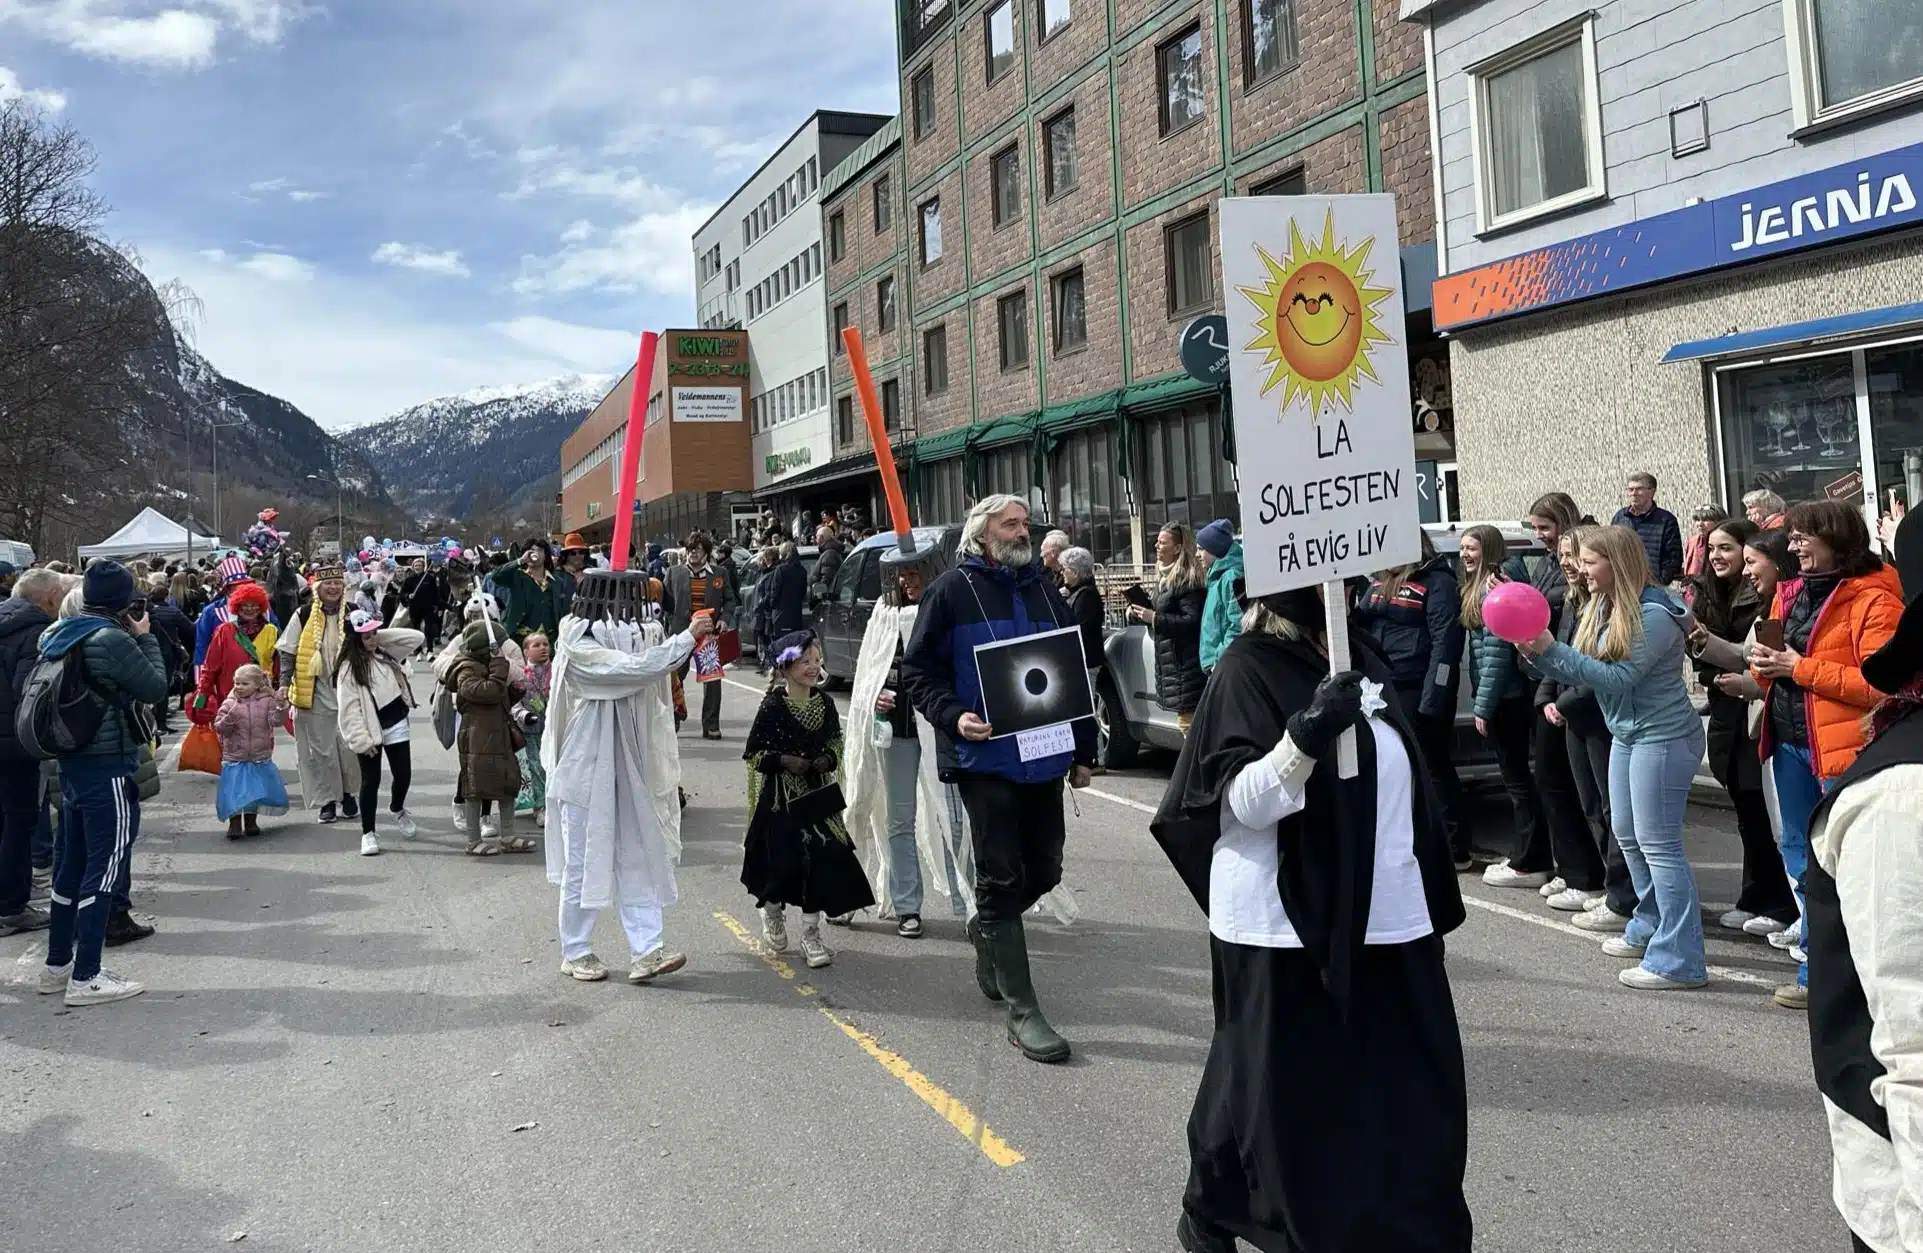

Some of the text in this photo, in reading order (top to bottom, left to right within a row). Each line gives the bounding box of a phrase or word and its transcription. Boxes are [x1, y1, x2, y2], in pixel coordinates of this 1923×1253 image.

[678, 336, 721, 356] KIWI
[1317, 419, 1352, 459] LA
[1259, 468, 1400, 525] SOLFESTEN
[1278, 532, 1301, 573] FÅ
[1024, 737, 1071, 757] SOLFEST
